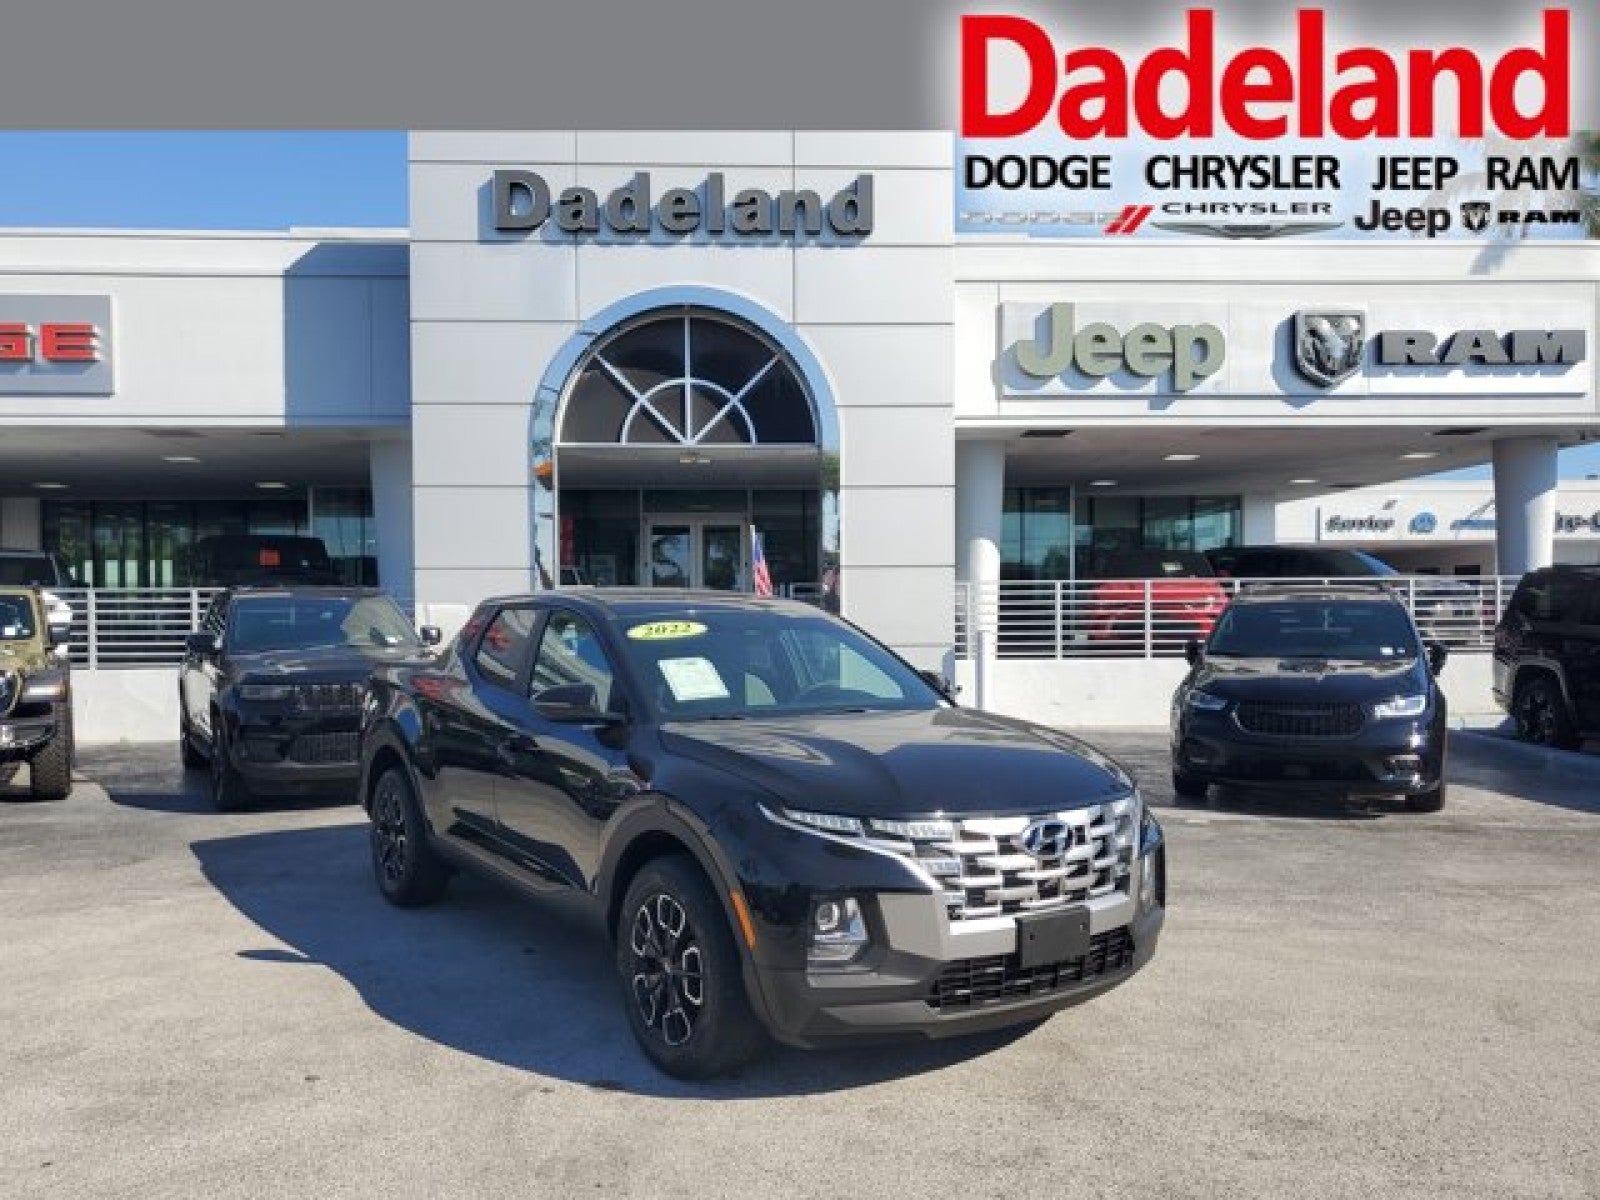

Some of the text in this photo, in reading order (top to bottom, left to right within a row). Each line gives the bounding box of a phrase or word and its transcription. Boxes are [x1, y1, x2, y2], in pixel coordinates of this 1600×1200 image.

[494, 170, 874, 236] Dadeland
[1016, 302, 1226, 393] Jeep
[1376, 329, 1586, 365] RAM
